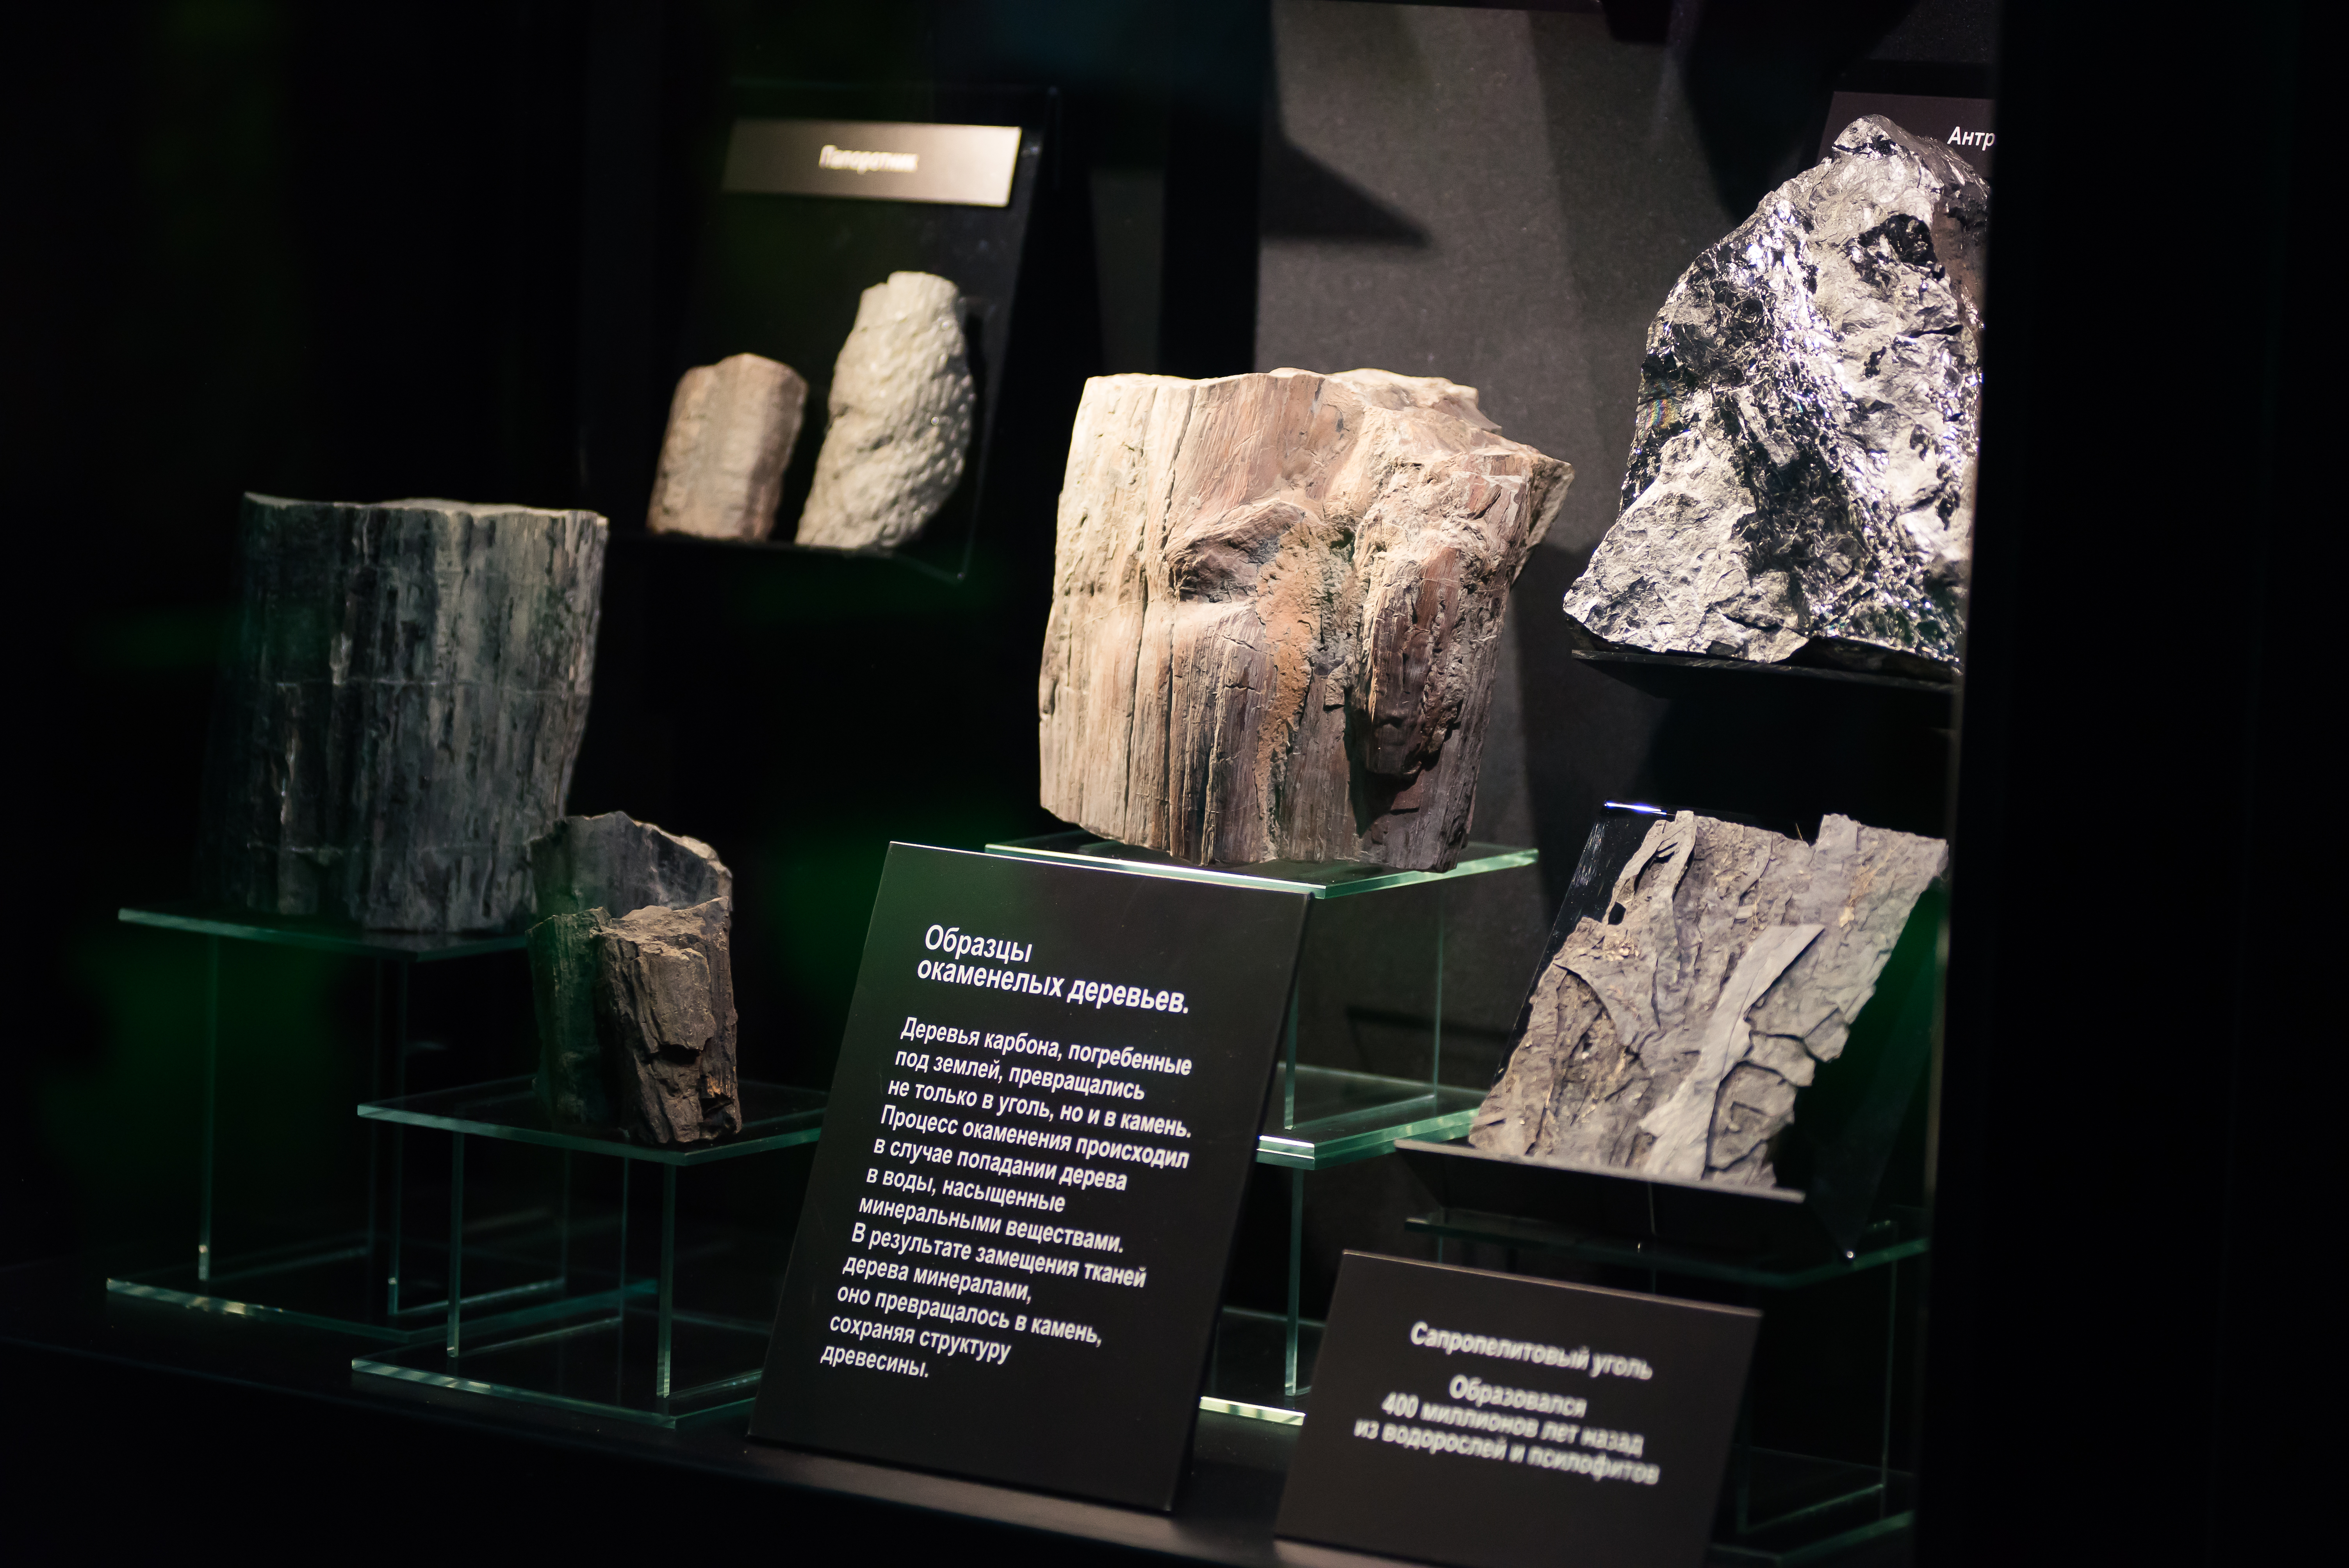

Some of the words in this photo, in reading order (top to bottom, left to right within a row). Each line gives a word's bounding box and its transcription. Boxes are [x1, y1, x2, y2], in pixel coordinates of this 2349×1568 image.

[925, 925, 1032, 964] Образцы
[918, 960, 1065, 997] окаменелых
[1067, 980, 1188, 1014] деревьев.
[900, 1017, 980, 1046] Деревья
[984, 1033, 1062, 1061] карбона,
[1068, 1044, 1192, 1075] погребенные
[895, 1051, 929, 1073] под
[933, 1057, 1002, 1083] землей,
[1009, 1067, 1144, 1099] превращались
[888, 1080, 909, 1096] не
[916, 1084, 977, 1107] только
[982, 1094, 994, 1109] в
[996, 1096, 1053, 1121] уголь,
[1060, 1105, 1083, 1122] но
[1087, 1109, 1100, 1124] и
[1104, 1111, 1116, 1126] в
[1120, 1113, 1191, 1138] камень.
[881, 1105, 958, 1134] Процесс
[963, 1122, 1072, 1151] окаменения
[1076, 1138, 1189, 1169] происходил
[866, 1169, 878, 1183] в
[882, 1171, 936, 1196] воды,
[943, 1180, 1065, 1212] насыщенные
[874, 1139, 885, 1153] в
[890, 1142, 952, 1164] случае
[957, 1151, 1057, 1180] попадании
[1059, 1167, 1127, 1190] дерева
[859, 1198, 1002, 1233] минеральными
[1006, 1221, 1123, 1253] веществами.
[843, 1257, 909, 1281] дерева
[913, 1268, 1031, 1304] минералами,
[852, 1222, 866, 1242] В
[868, 1230, 971, 1260] результате
[976, 1247, 1079, 1277] замещения
[1085, 1263, 1146, 1287] тканей
[831, 1316, 915, 1343] сохраняя
[920, 1331, 1011, 1365] структуру
[838, 1286, 870, 1305] оно
[875, 1292, 1009, 1328] превращалось
[1015, 1315, 1027, 1331] в
[1031, 1318, 1101, 1347] камень,
[820, 1346, 928, 1377] древесины.
[1412, 1322, 1589, 1368] Сапропелитовый
[1591, 1354, 1652, 1379] уголь
[1450, 1376, 1586, 1417] Образовался
[1355, 1420, 1378, 1438] из
[1383, 1424, 1506, 1459] водорослей
[1510, 1445, 1525, 1462] и
[1528, 1447, 1659, 1484] псилофитов
[1382, 1393, 1418, 1417] 400
[1420, 1403, 1538, 1437] миллионов
[1541, 1422, 1579, 1443] лет
[1581, 1429, 1643, 1457] назад
